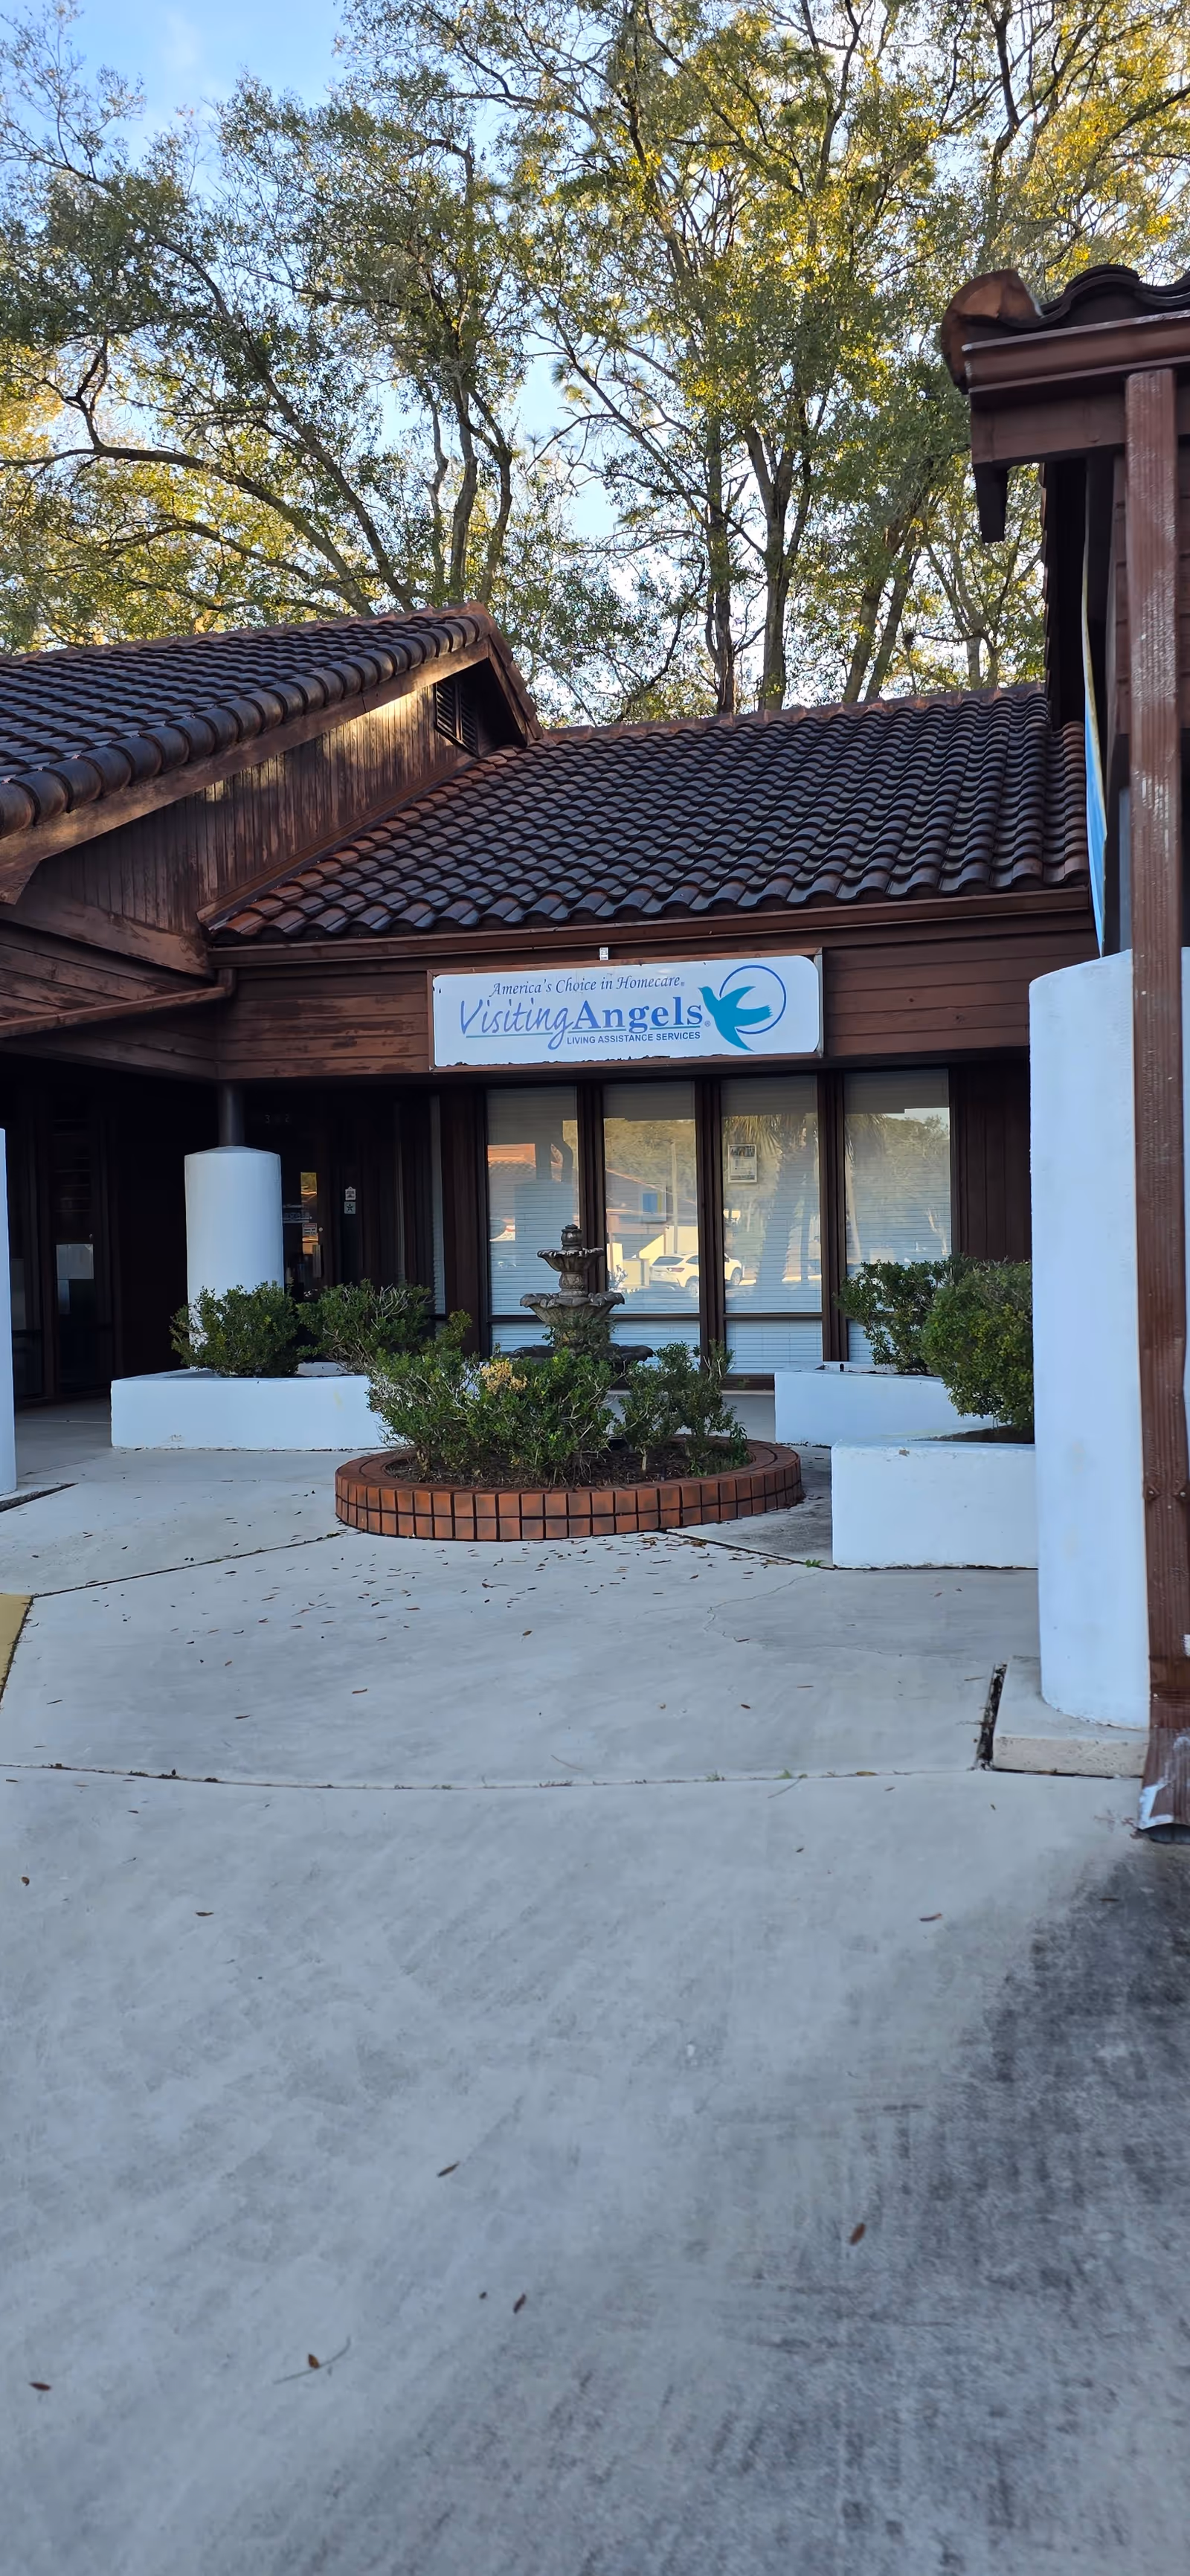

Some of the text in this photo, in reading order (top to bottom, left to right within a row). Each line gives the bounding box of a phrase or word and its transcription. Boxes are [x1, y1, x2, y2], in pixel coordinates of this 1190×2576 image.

[489, 979, 552, 998] America's
[556, 977, 596, 994] Choice
[601, 977, 612, 990] in
[567, 1031, 701, 1044] LIVING ASSISTANCE SERVICES
